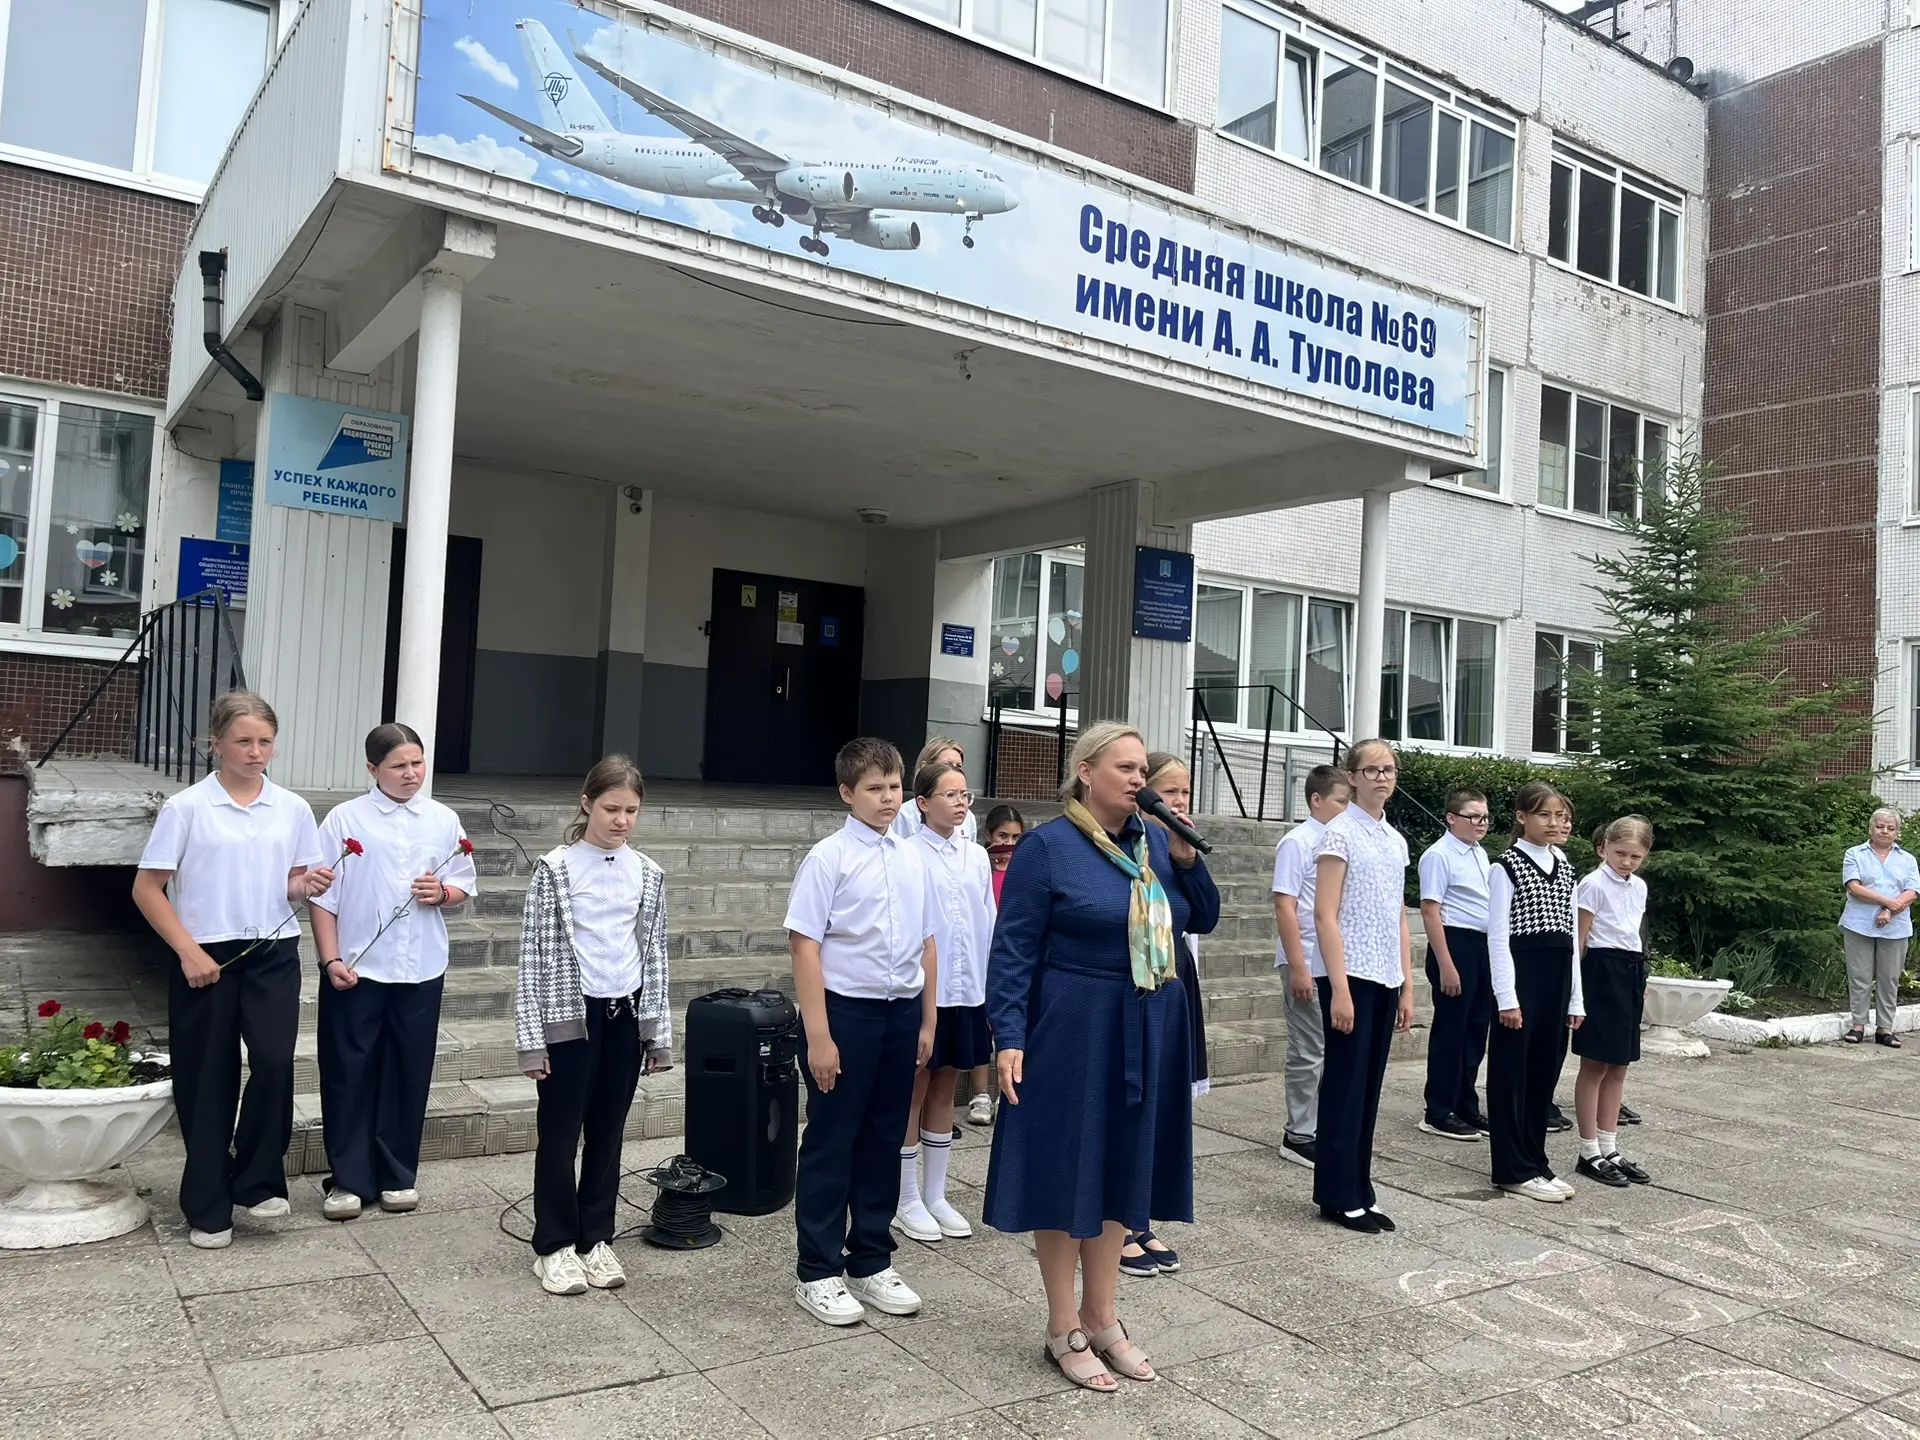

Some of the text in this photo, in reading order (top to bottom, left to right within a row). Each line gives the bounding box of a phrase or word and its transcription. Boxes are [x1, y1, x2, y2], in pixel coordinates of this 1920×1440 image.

[1079, 204, 1437, 359] Средняя школа №69
[1075, 274, 1435, 412] имени А. А. Туполева
[350, 419, 394, 433] ОБРАЗОВАНИЕ
[342, 428, 392, 443] НАЦИОНАЛЬНЫЕ
[363, 439, 392, 450] ПРОЕКТЫ
[367, 448, 391, 458] РОССИИ
[274, 469, 397, 499] УСПЕХ КАЖДОГО
[302, 490, 369, 511] РЕБЕНКА
